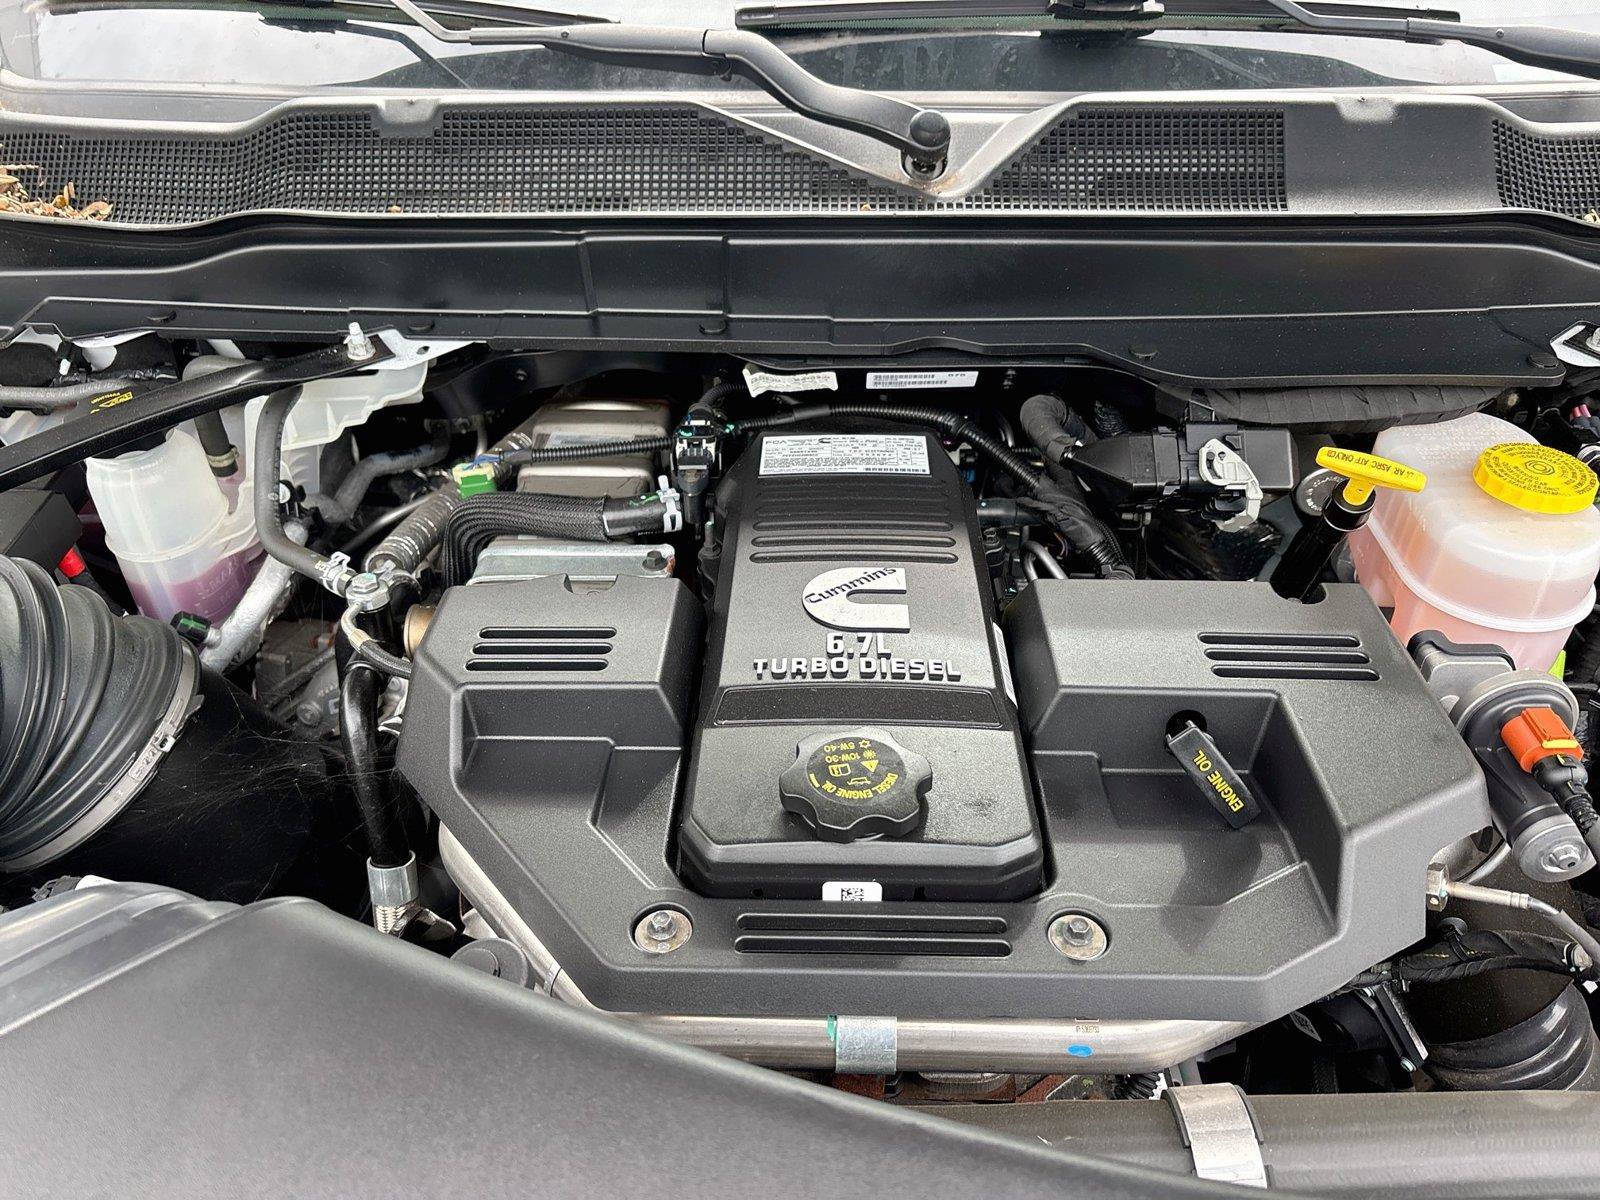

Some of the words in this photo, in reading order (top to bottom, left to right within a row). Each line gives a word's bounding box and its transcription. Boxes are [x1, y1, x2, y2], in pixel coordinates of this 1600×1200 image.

[804, 567, 897, 604] Cummins
[827, 633, 891, 659] 6.7L
[753, 657, 849, 680] TURBO
[859, 657, 962, 681] DIESEL
[824, 742, 856, 753] 5W-40
[825, 752, 861, 763] 10W-30
[1193, 749, 1212, 772] OIL
[821, 780, 836, 793] OIL
[835, 787, 874, 799] ENGINE
[874, 773, 899, 794] DIESEL
[1206, 770, 1245, 812] ENGINE
